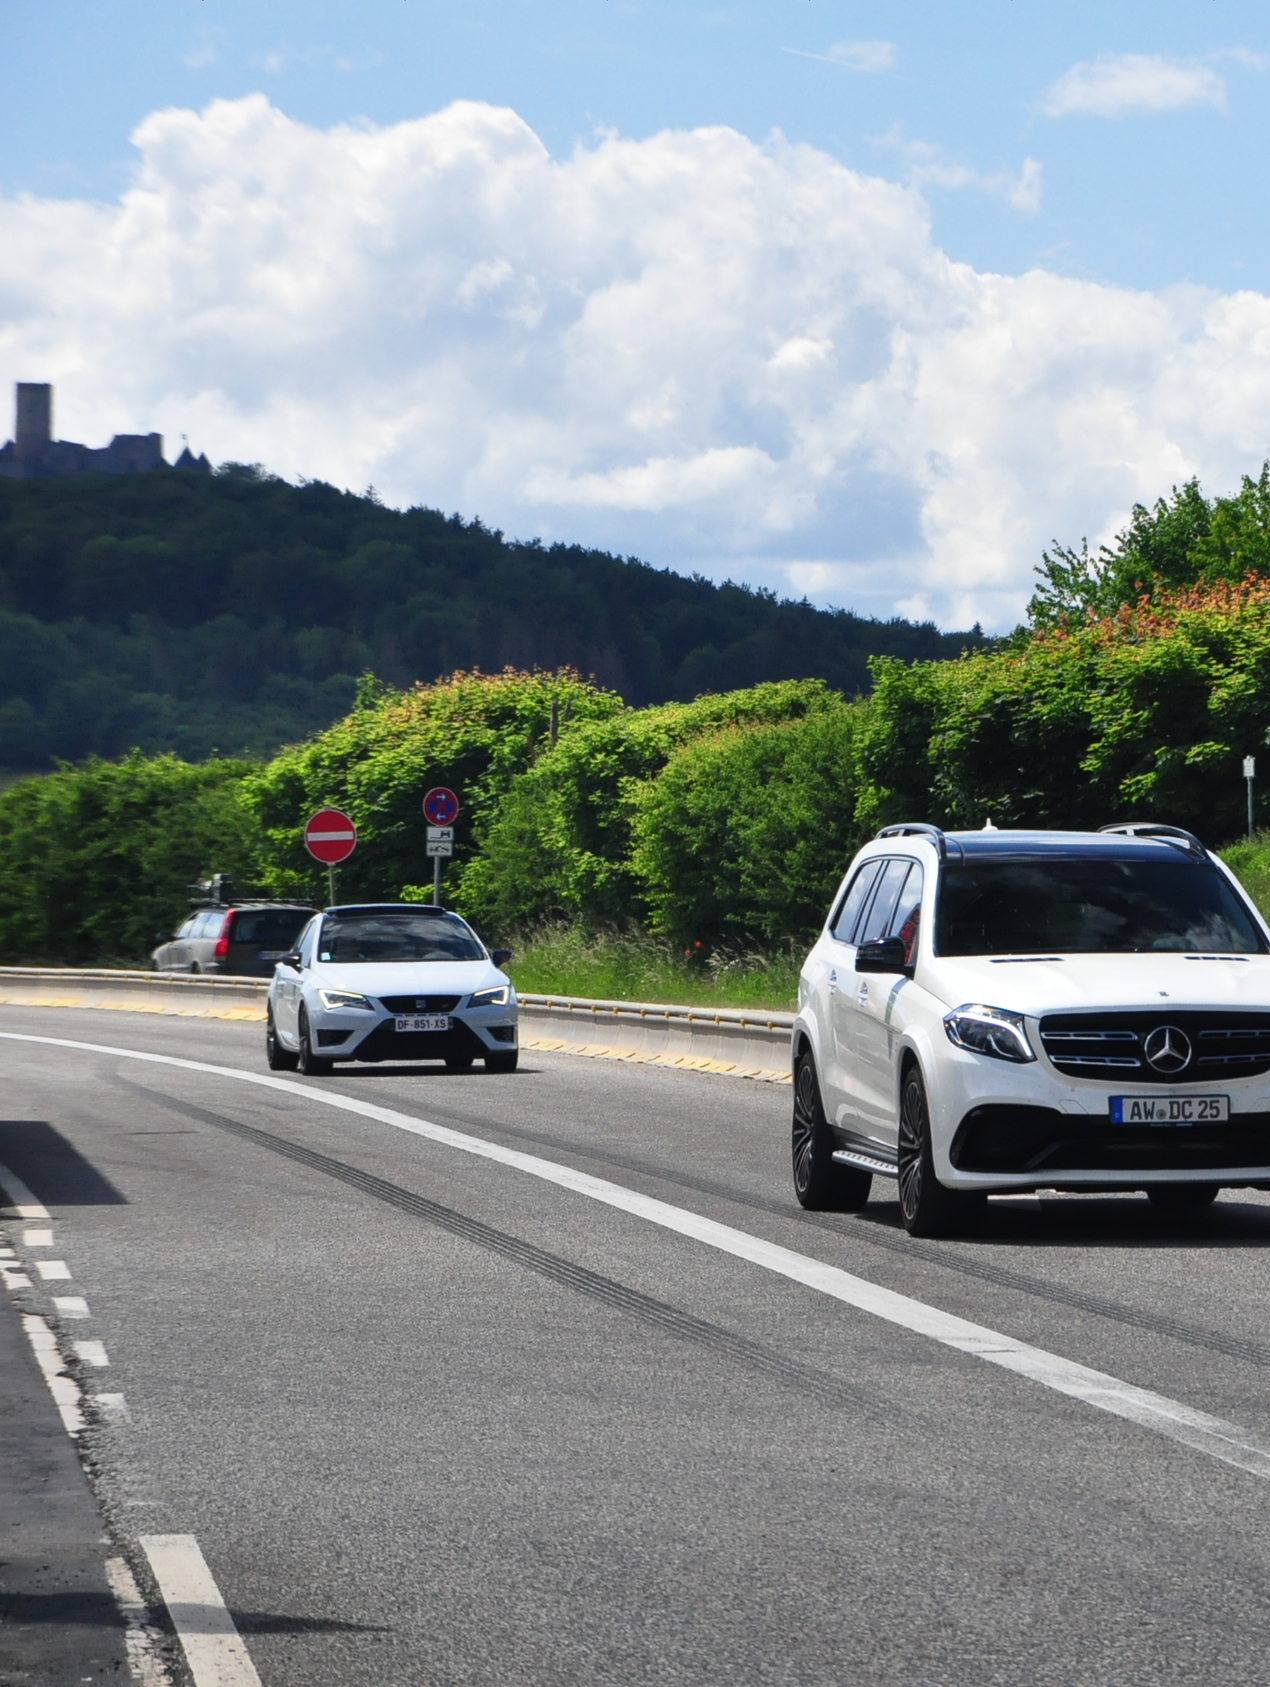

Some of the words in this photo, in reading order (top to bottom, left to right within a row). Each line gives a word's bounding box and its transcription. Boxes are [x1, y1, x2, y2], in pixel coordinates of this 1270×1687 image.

[397, 1019, 446, 1030] DF-851-XS
[1129, 1101, 1155, 1120] AW
[1168, 1100, 1193, 1119] DC
[1197, 1099, 1220, 1119] 25
